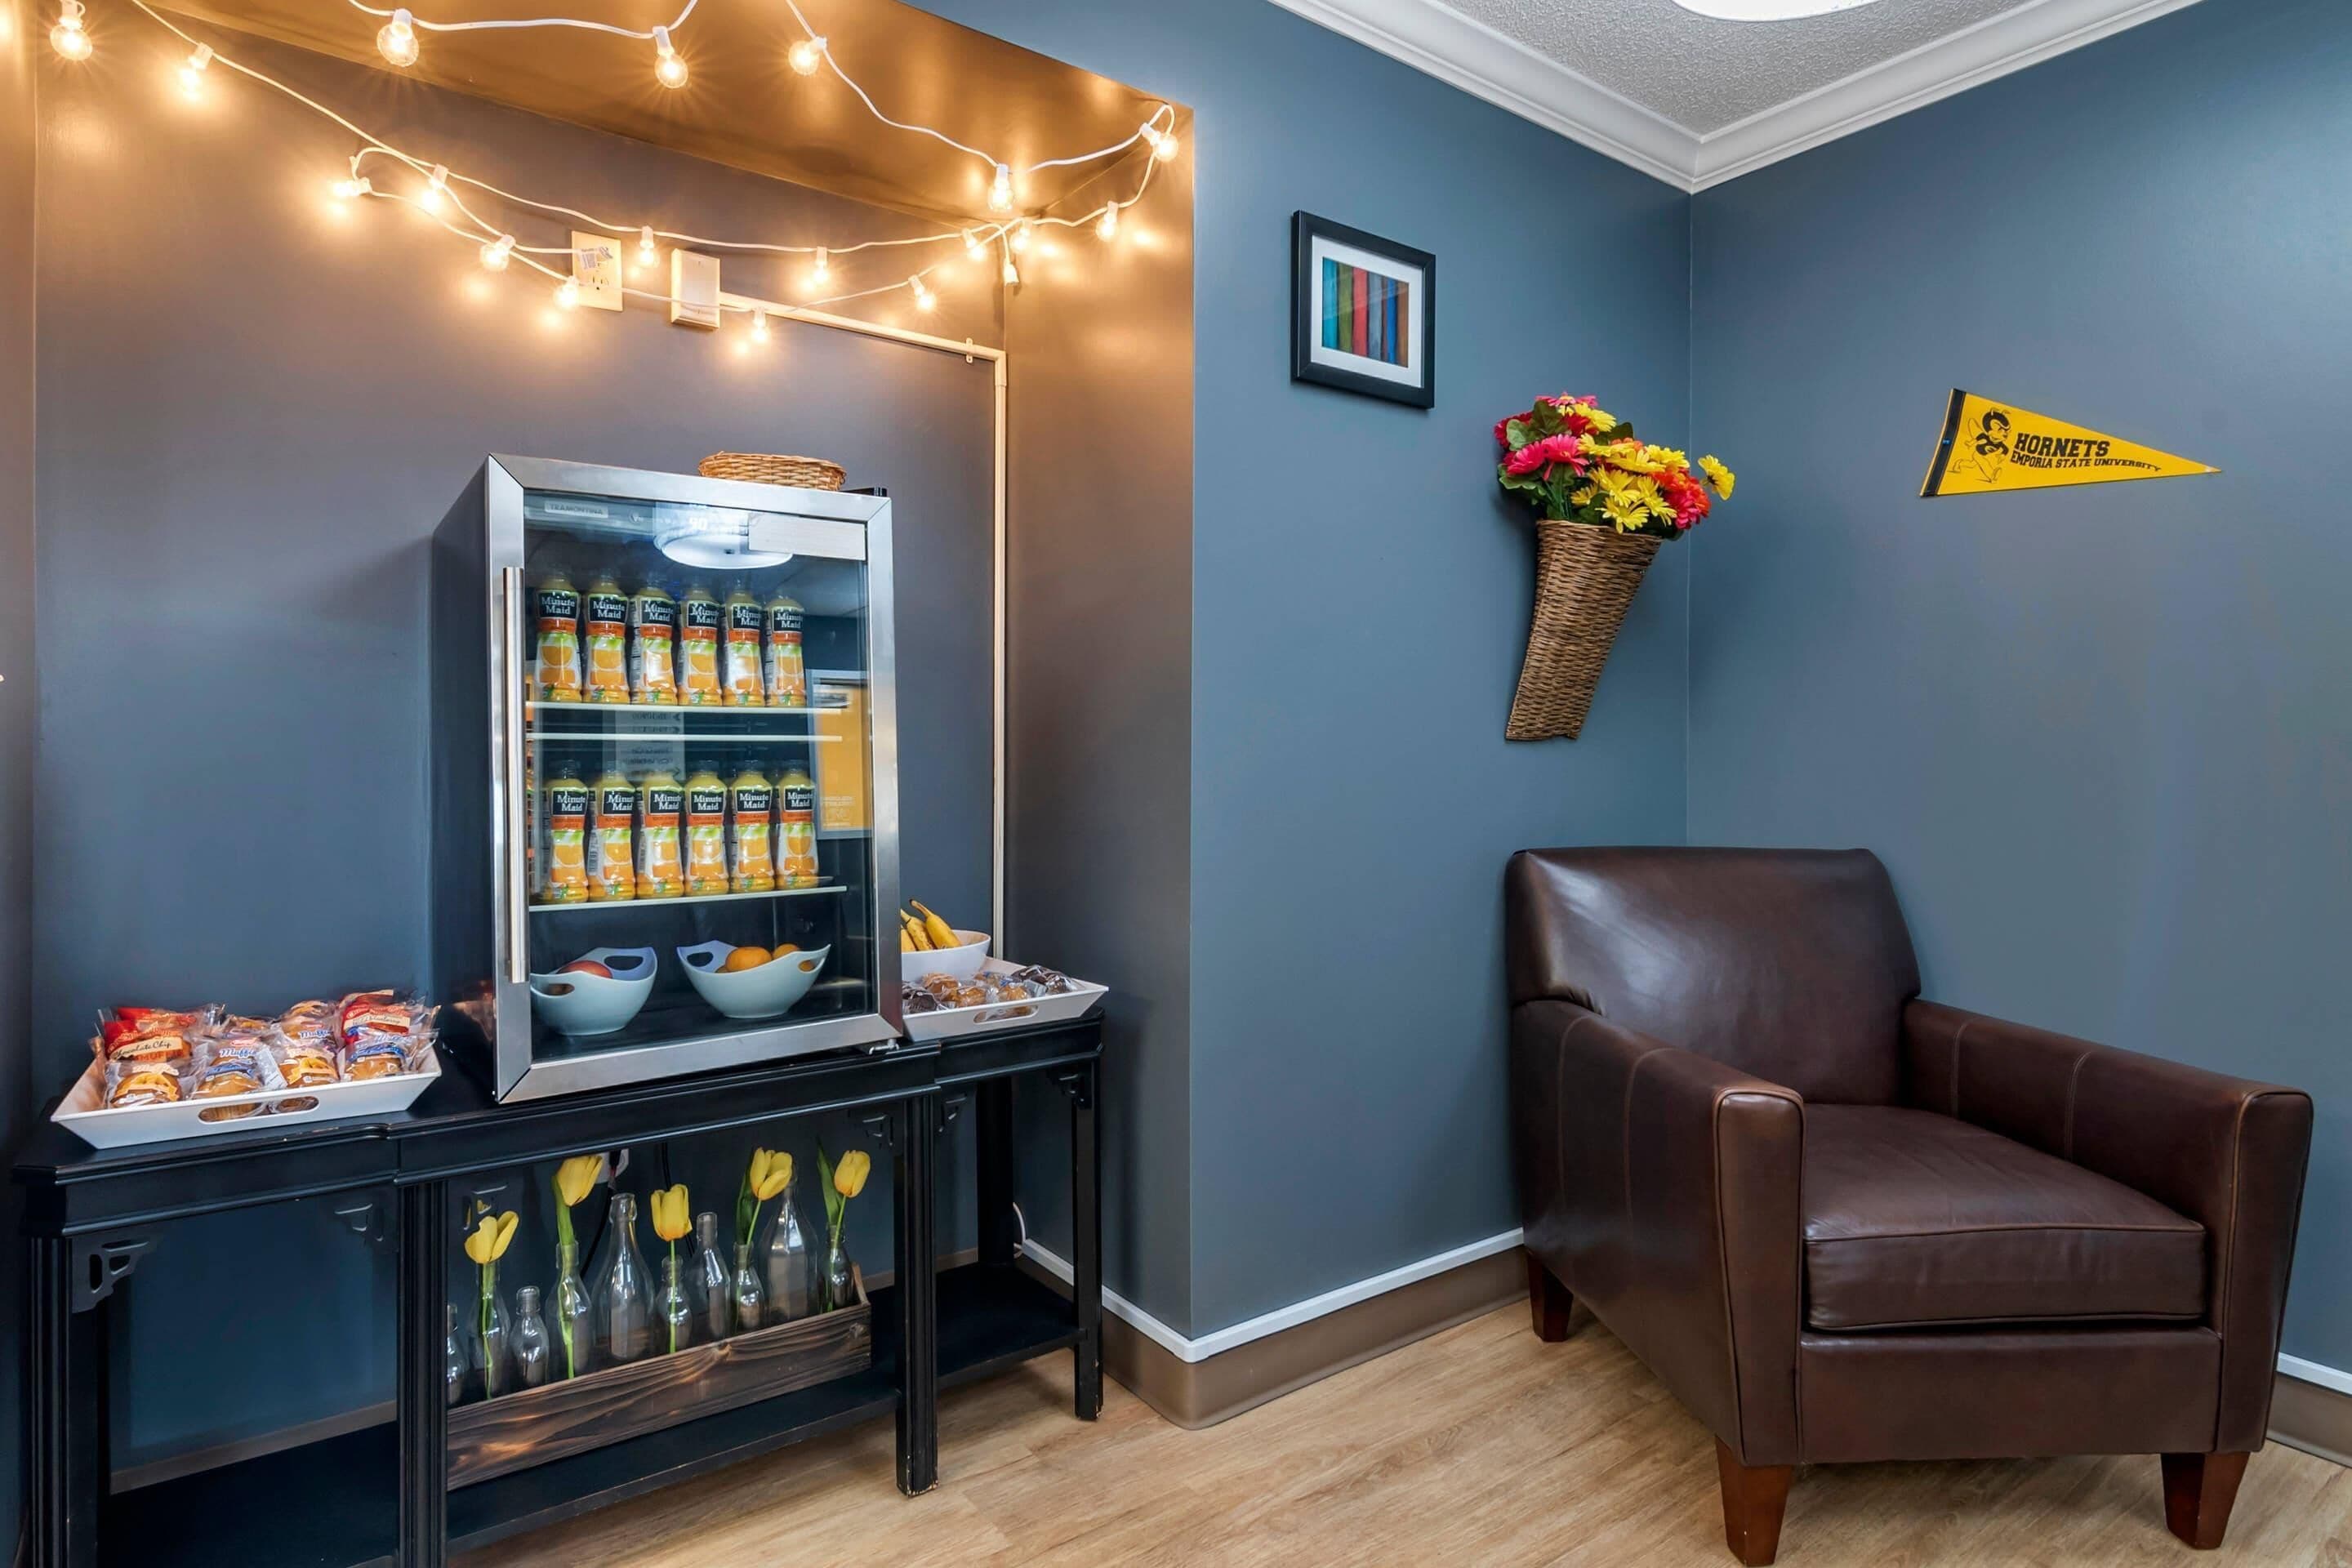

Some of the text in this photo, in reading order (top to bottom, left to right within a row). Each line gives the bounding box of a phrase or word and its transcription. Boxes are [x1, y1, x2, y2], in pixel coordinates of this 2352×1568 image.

[2014, 433, 2110, 457] HORNETS
[2010, 450, 2162, 471] EMPORIA STATE UNIVERSITY
[541, 596, 576, 608] Minute
[593, 600, 626, 612] Minute
[546, 605, 571, 614] Maid
[597, 609, 621, 619] Maid
[649, 612, 670, 621] Maid
[781, 620, 801, 629] Maid
[557, 794, 586, 804] Minute
[694, 794, 722, 804] Minute
[739, 793, 769, 802] Minute
[561, 803, 583, 812] Maid
[658, 801, 679, 810] Maid
[697, 802, 719, 811] Maid
[743, 800, 765, 809] Maid
[791, 799, 810, 808] Maid
[153, 1040, 172, 1049] Chip
